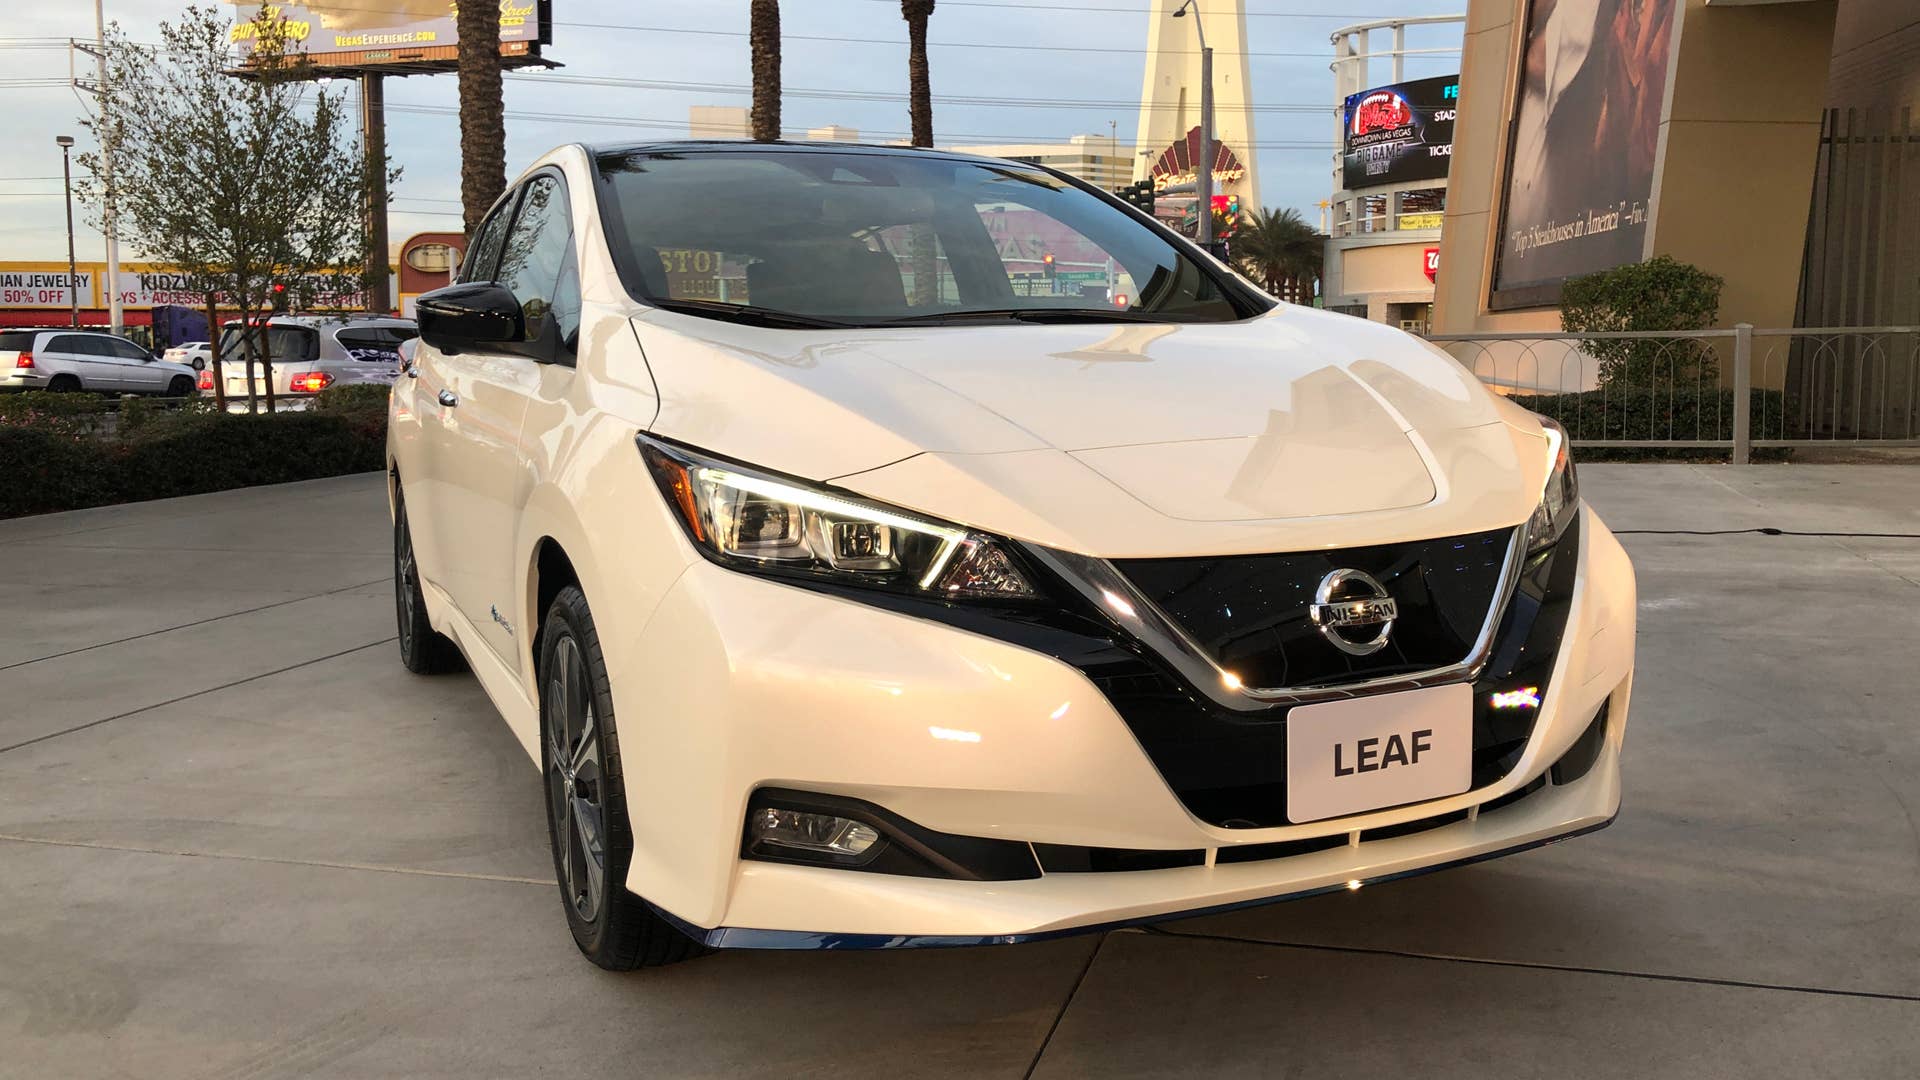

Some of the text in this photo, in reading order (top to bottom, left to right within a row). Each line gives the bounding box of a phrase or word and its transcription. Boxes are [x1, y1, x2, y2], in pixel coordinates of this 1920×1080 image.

[1351, 127, 1412, 146] DOWNTOWN LAS VEGAS
[1356, 142, 1404, 163] BIG GAME
[1533, 220, 1575, 248] Steakhouses
[1574, 212, 1584, 237] in
[26, 274, 89, 288] JEWELRY
[4, 290, 65, 303] 50% OFF
[104, 292, 137, 304] TYS
[1326, 602, 1394, 622] NISSAN
[1334, 729, 1433, 778] LEAF
